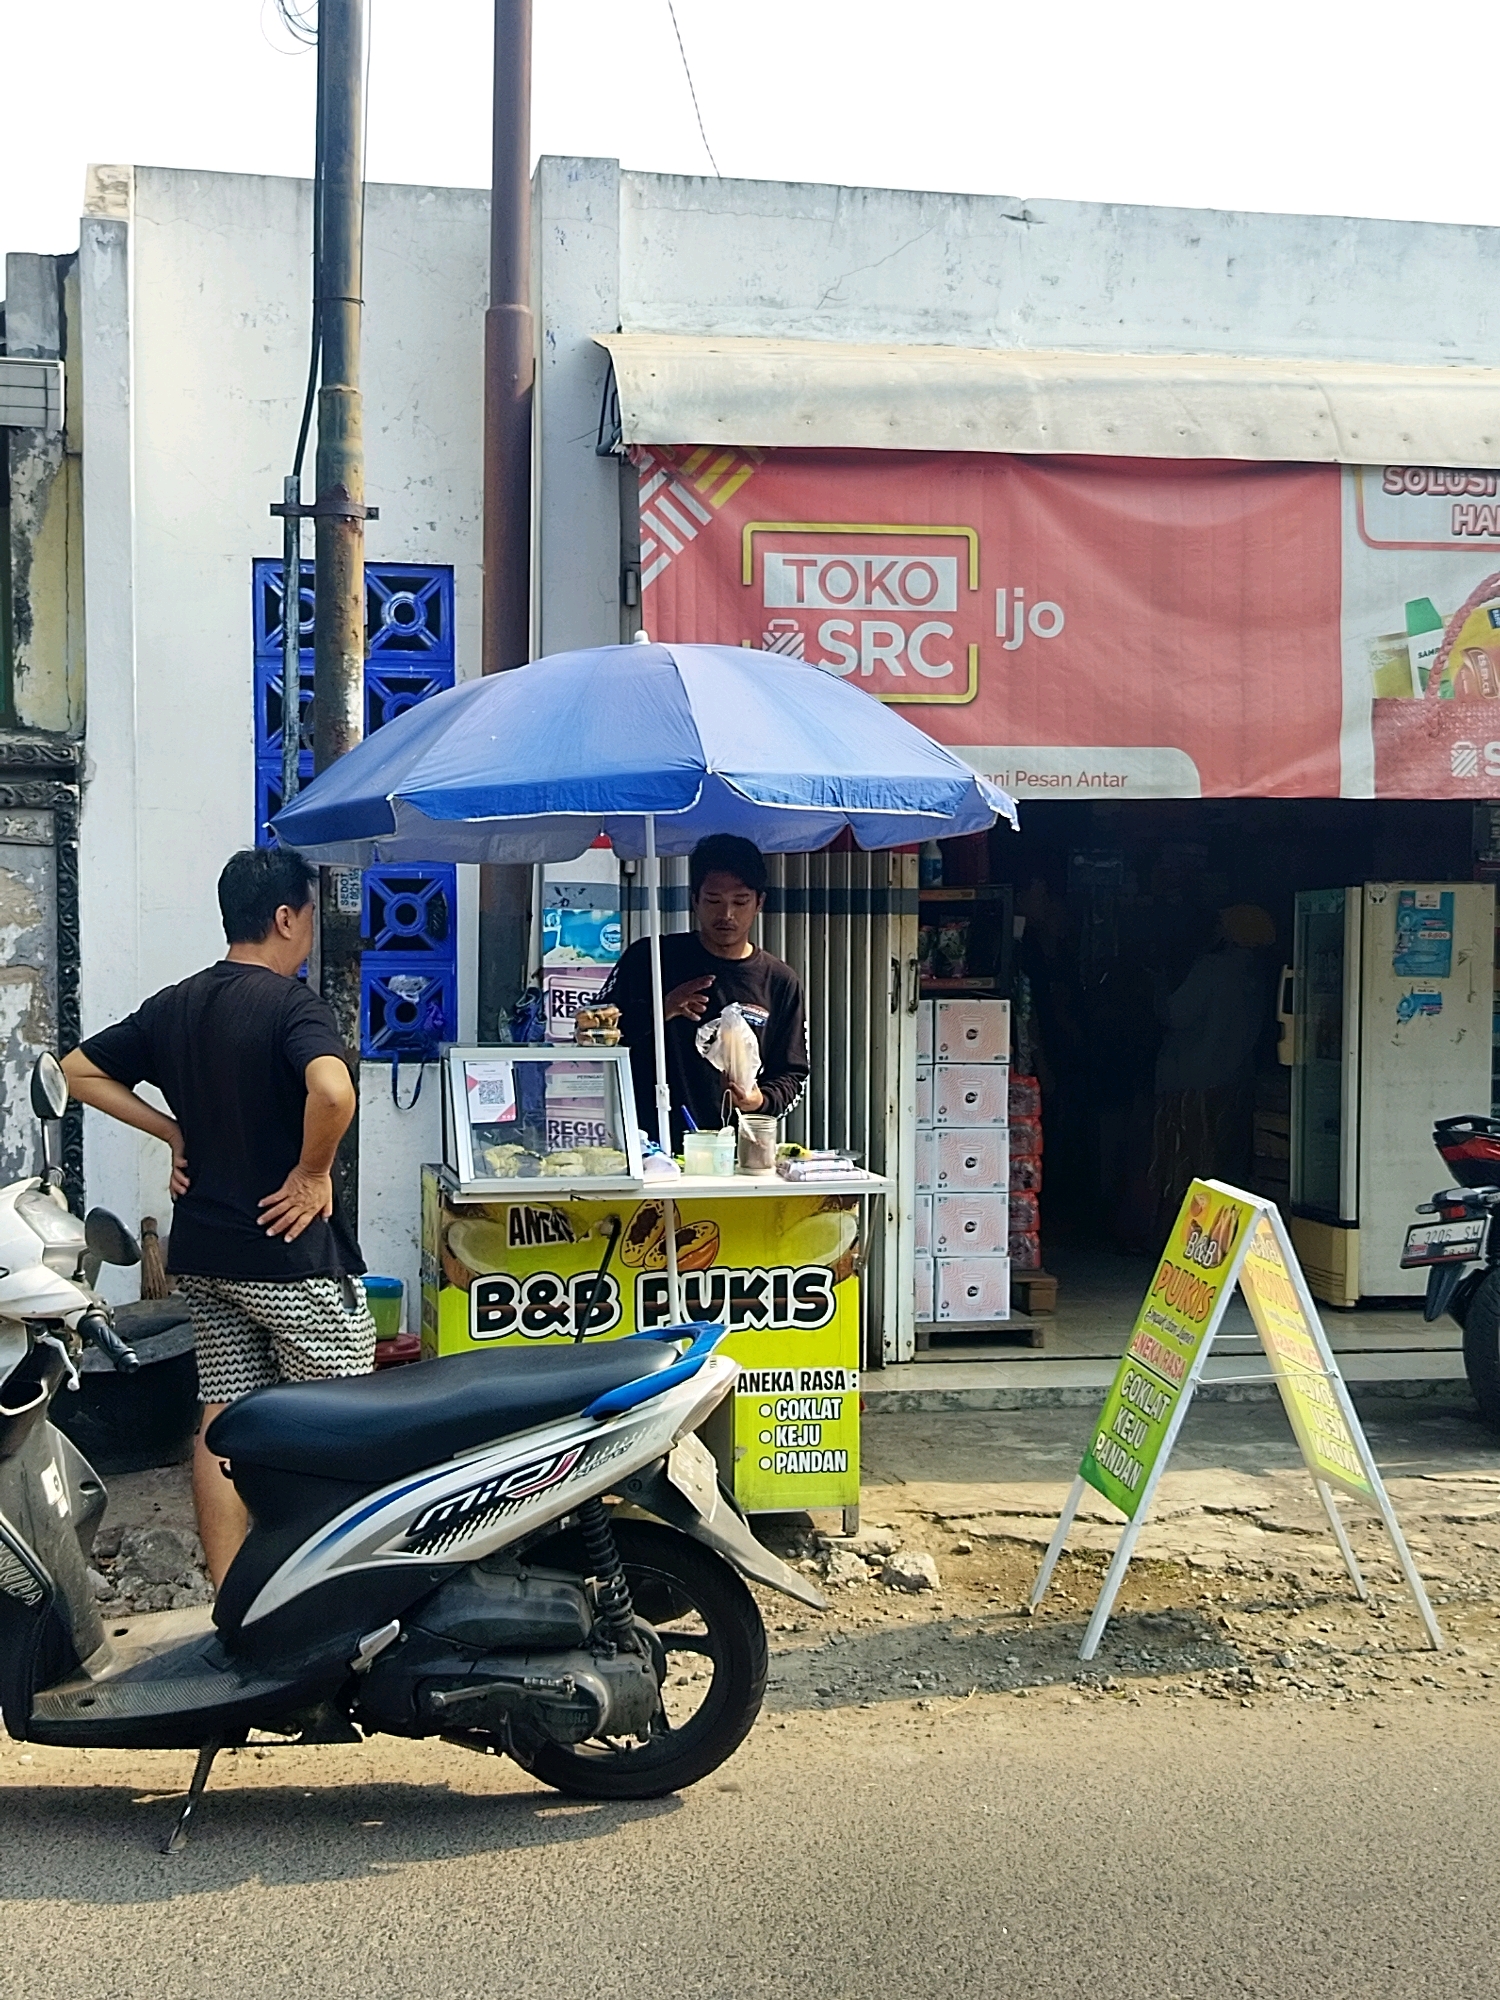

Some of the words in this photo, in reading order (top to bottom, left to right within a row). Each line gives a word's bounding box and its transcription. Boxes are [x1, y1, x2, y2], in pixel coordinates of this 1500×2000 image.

[1452, 504, 1500, 536] HA
[782, 558, 939, 607] TOKO
[995, 587, 1065, 651] Ijo
[817, 618, 954, 679] SRC
[1015, 770, 1072, 788] Pesan
[1076, 770, 1128, 788] Antar
[1184, 1231, 1218, 1269] B&B
[472, 1273, 620, 1339] B&B
[636, 1266, 836, 1332] PUKIS
[1152, 1260, 1217, 1323] PUKIS
[1130, 1330, 1163, 1364] ANEKA
[1161, 1348, 1187, 1380] RASA
[737, 1371, 795, 1393] ANEKA
[800, 1370, 846, 1392] RASA
[1120, 1368, 1171, 1424] COKLAT
[775, 1397, 843, 1421] COKLAT
[1112, 1404, 1149, 1450] KEJU
[775, 1424, 821, 1448] KEJU
[775, 1449, 847, 1474] PANDAN
[1092, 1430, 1144, 1492] PANDAN
